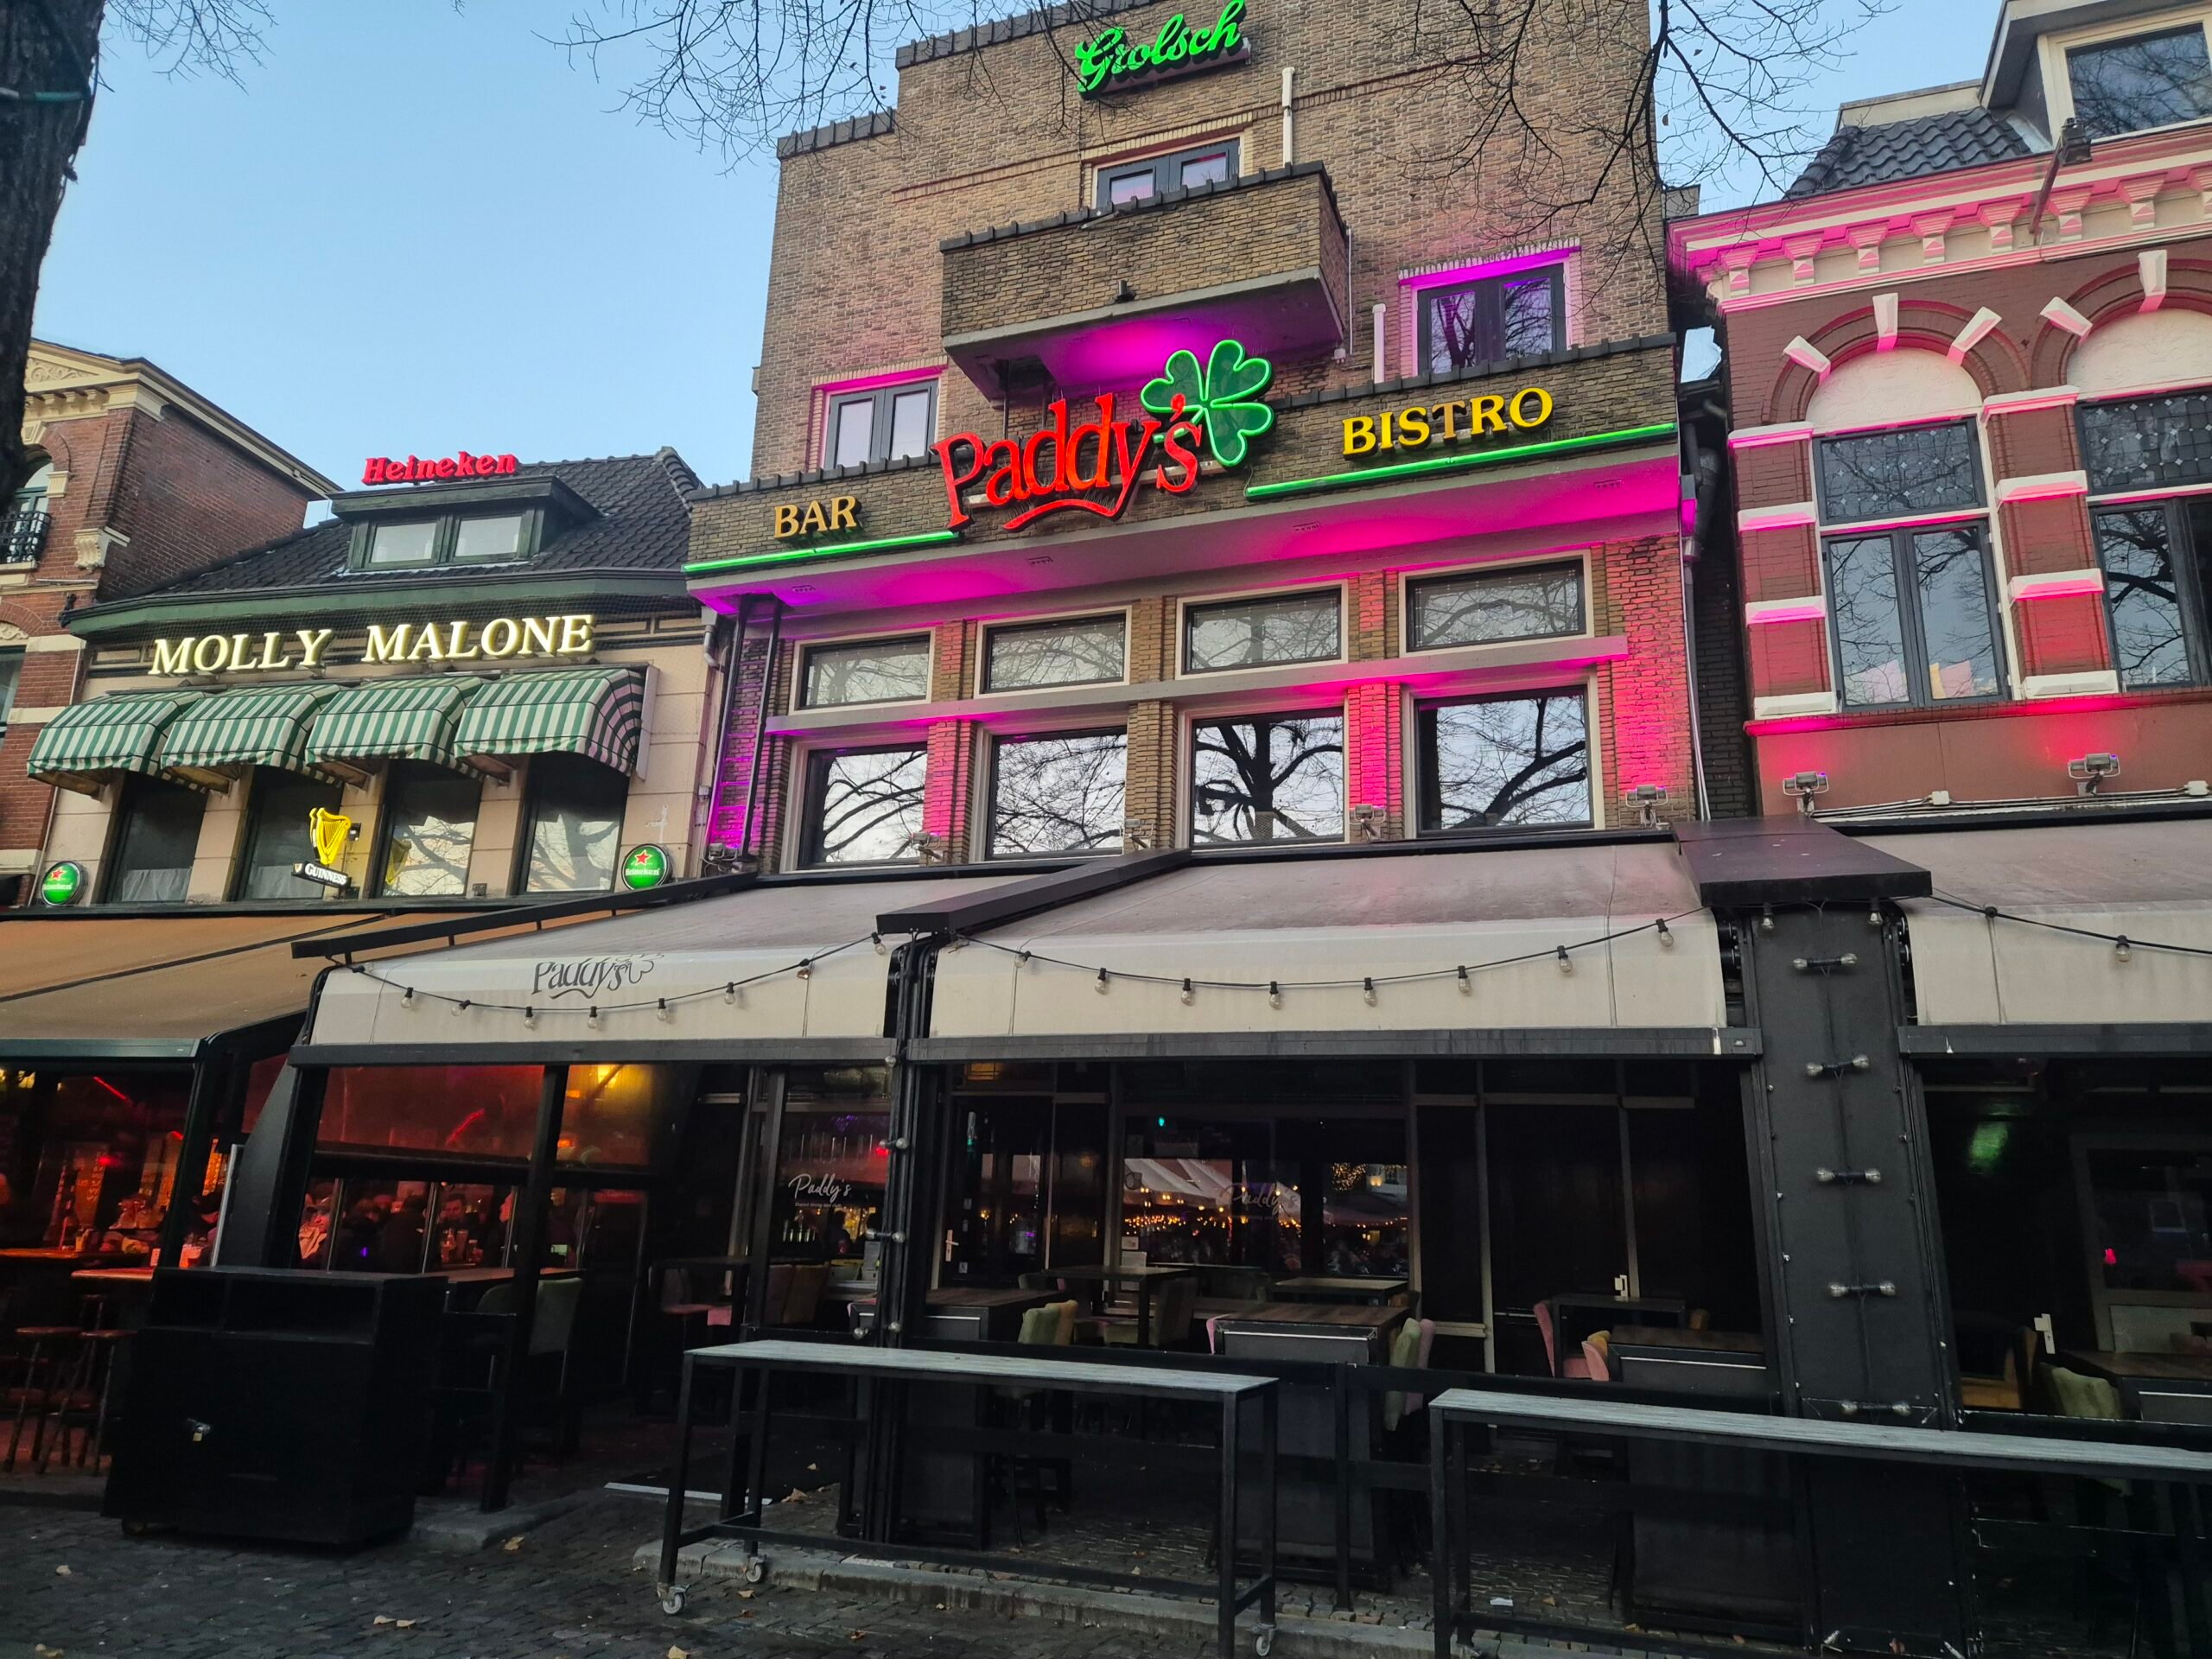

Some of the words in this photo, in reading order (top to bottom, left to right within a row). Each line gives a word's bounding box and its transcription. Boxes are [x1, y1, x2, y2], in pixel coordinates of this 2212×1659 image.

[1074, 0, 1242, 92] Grolsch
[1342, 387, 1554, 455] BISTRO
[361, 450, 518, 486] Heineken
[930, 391, 1203, 531] Paddy's
[773, 495, 857, 538] BAR
[148, 628, 334, 676] MOLLY
[360, 613, 596, 664] MALONE
[304, 862, 347, 886] GUINNESS
[787, 1173, 852, 1204] Paddy's
